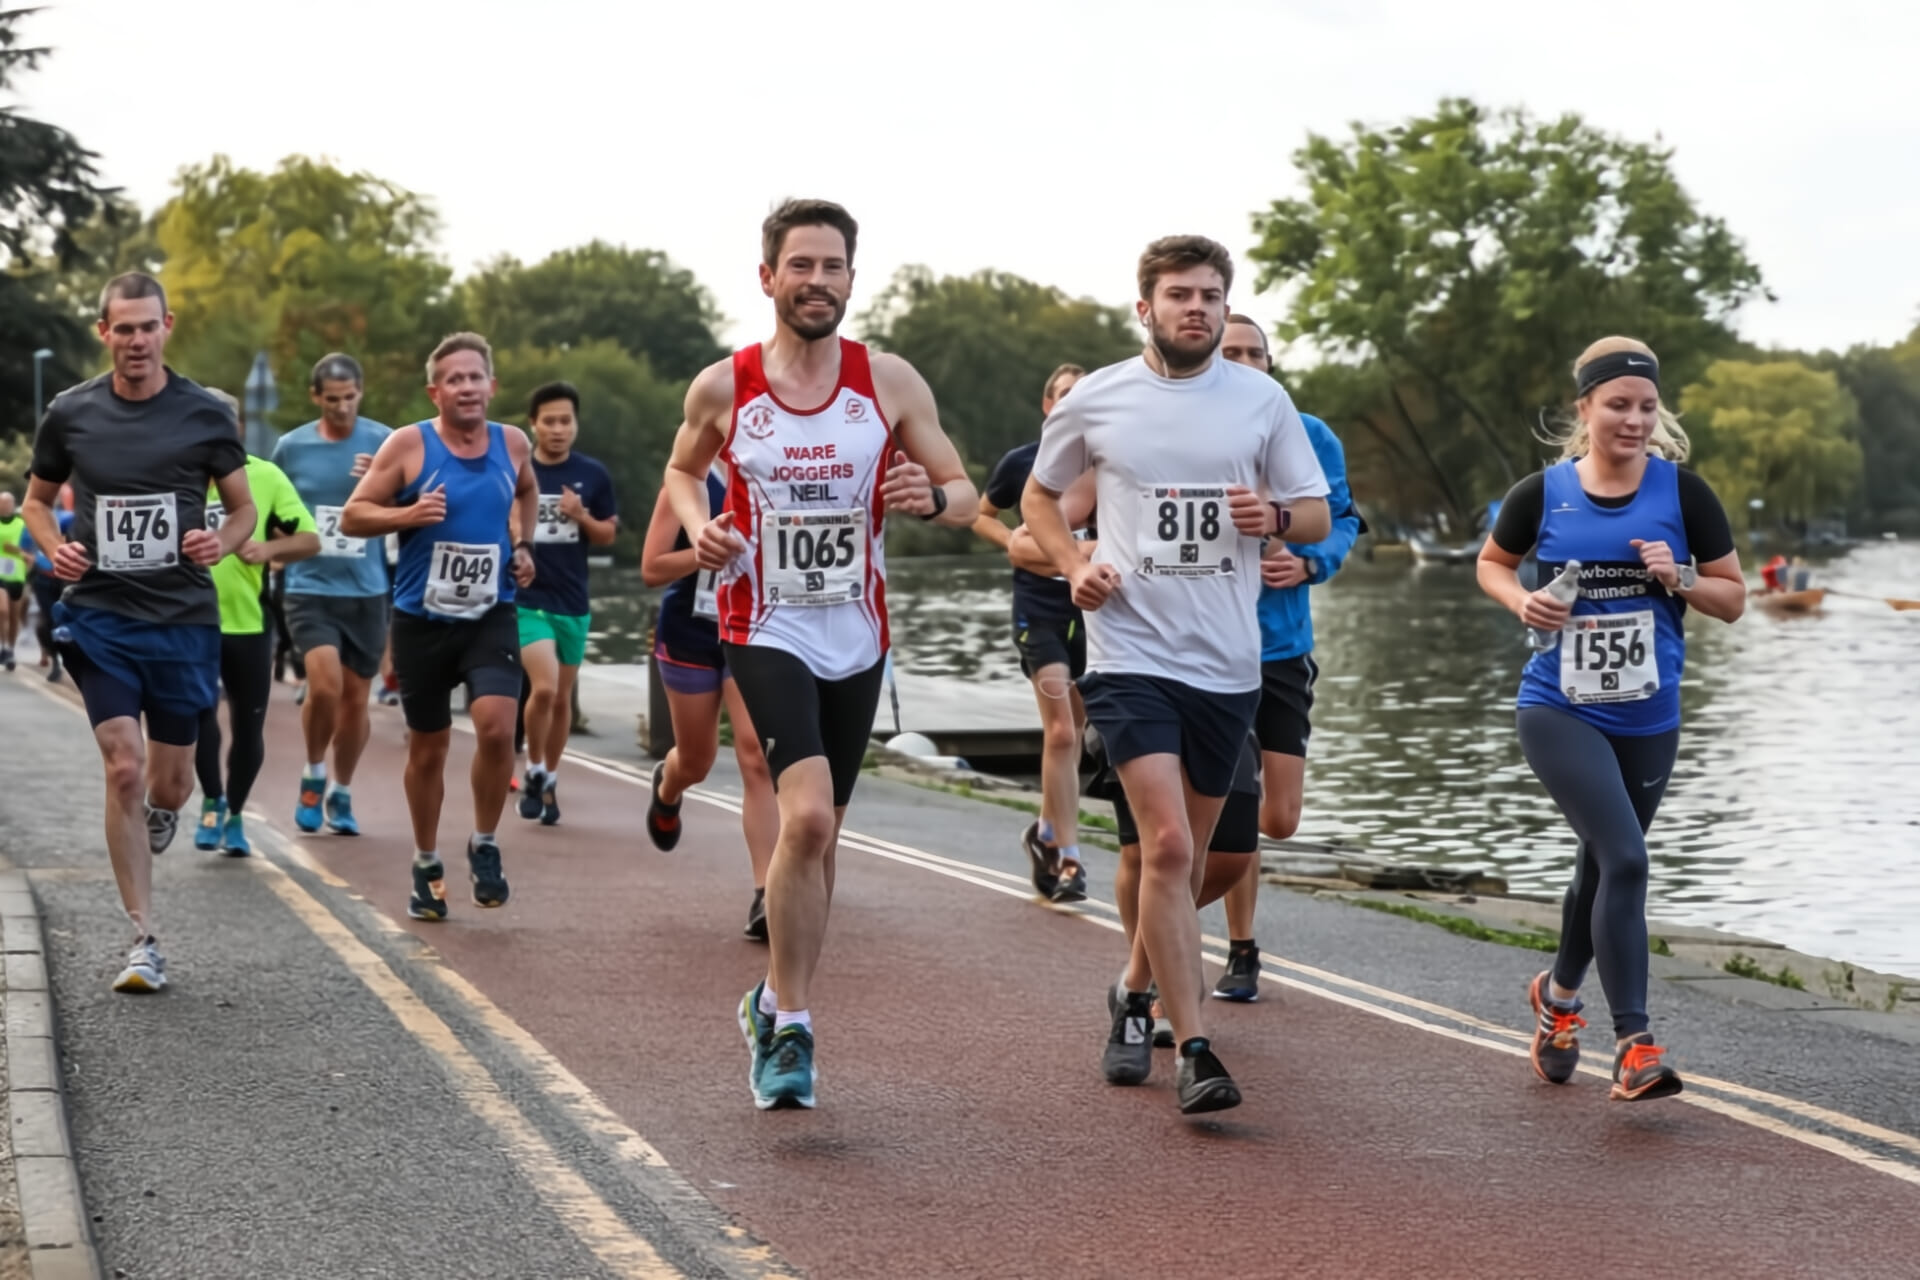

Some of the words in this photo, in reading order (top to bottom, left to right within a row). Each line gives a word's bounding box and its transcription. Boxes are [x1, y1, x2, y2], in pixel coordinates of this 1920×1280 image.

[783, 444, 836, 461] WARE
[769, 463, 854, 482] JOGGERS
[789, 484, 838, 502] NEIL
[106, 507, 170, 542] 1476
[1158, 501, 1220, 541] 818
[777, 527, 855, 570] 1065
[439, 552, 493, 584] 1049
[1574, 629, 1646, 671] 1556
